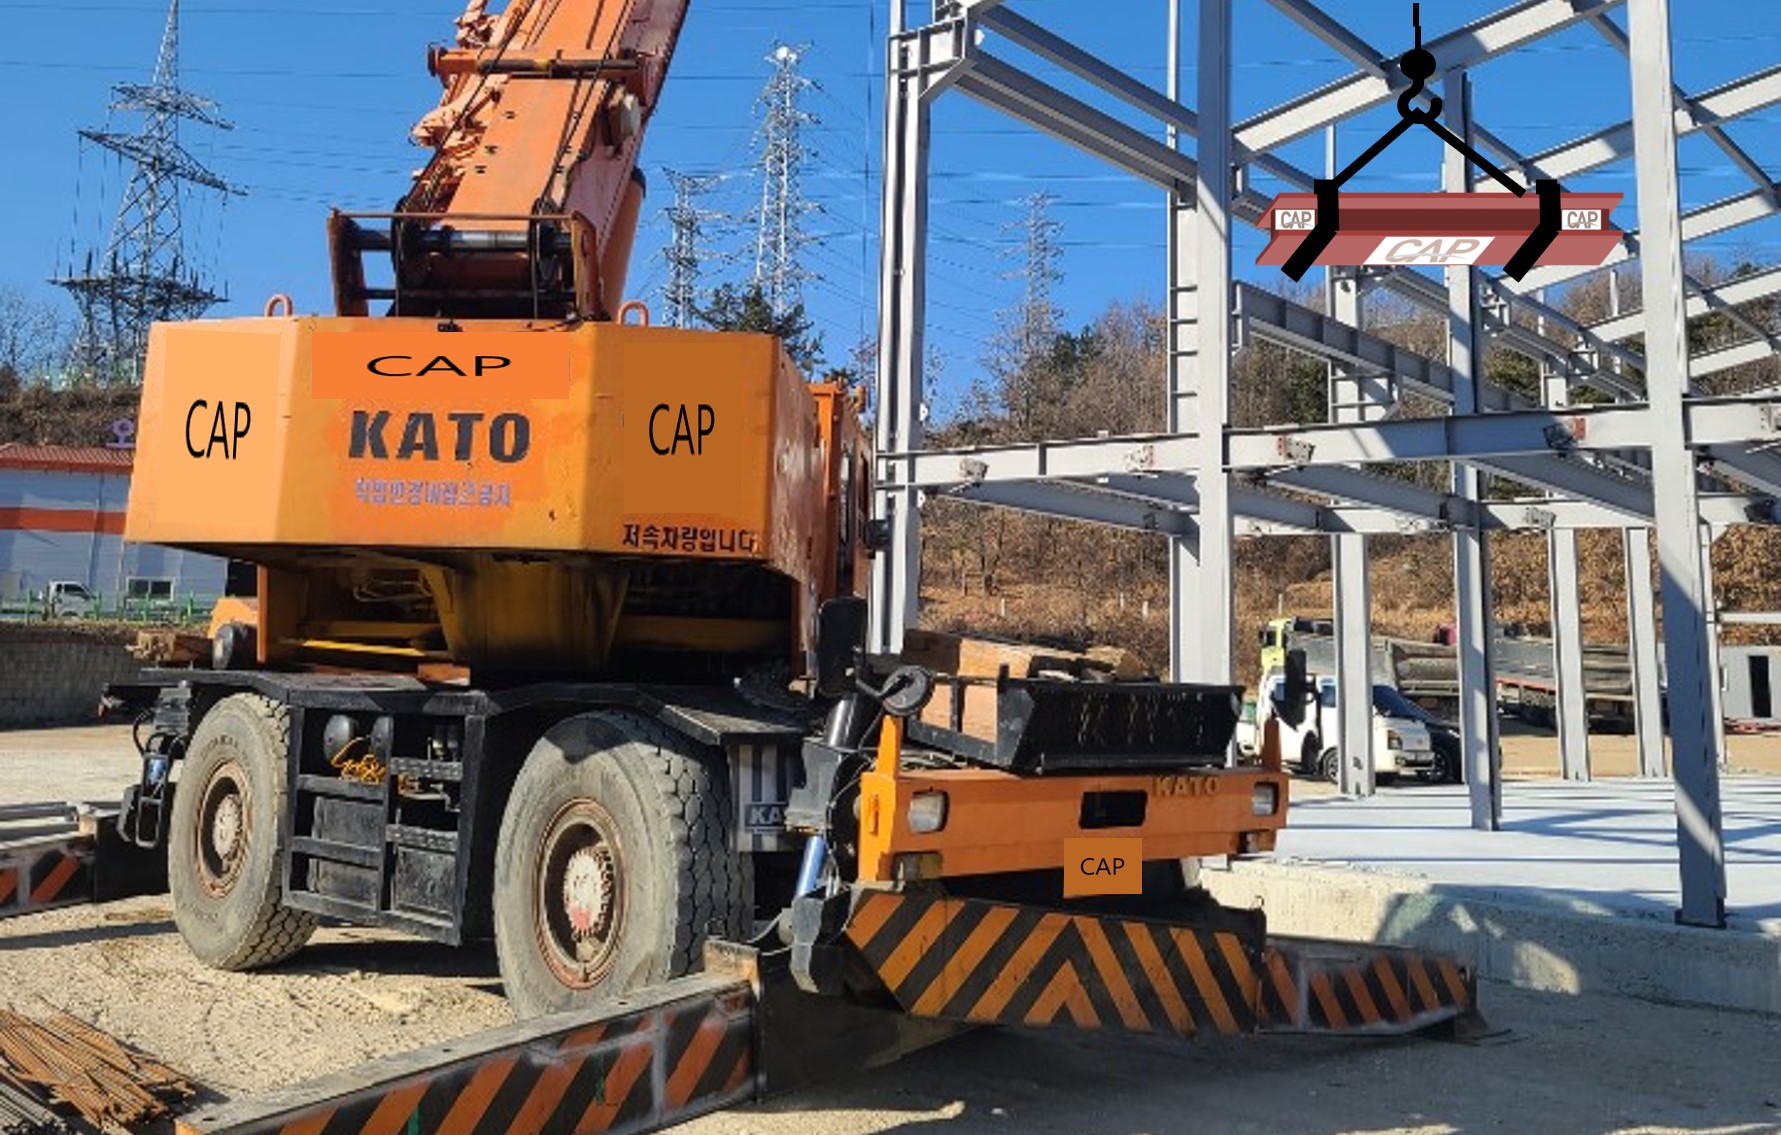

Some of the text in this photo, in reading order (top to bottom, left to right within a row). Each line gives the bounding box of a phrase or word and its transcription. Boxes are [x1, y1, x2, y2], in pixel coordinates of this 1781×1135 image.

[349, 410, 531, 462] KATO
[622, 524, 757, 552] 저속차량입니다
[1155, 776, 1219, 796] KATO
